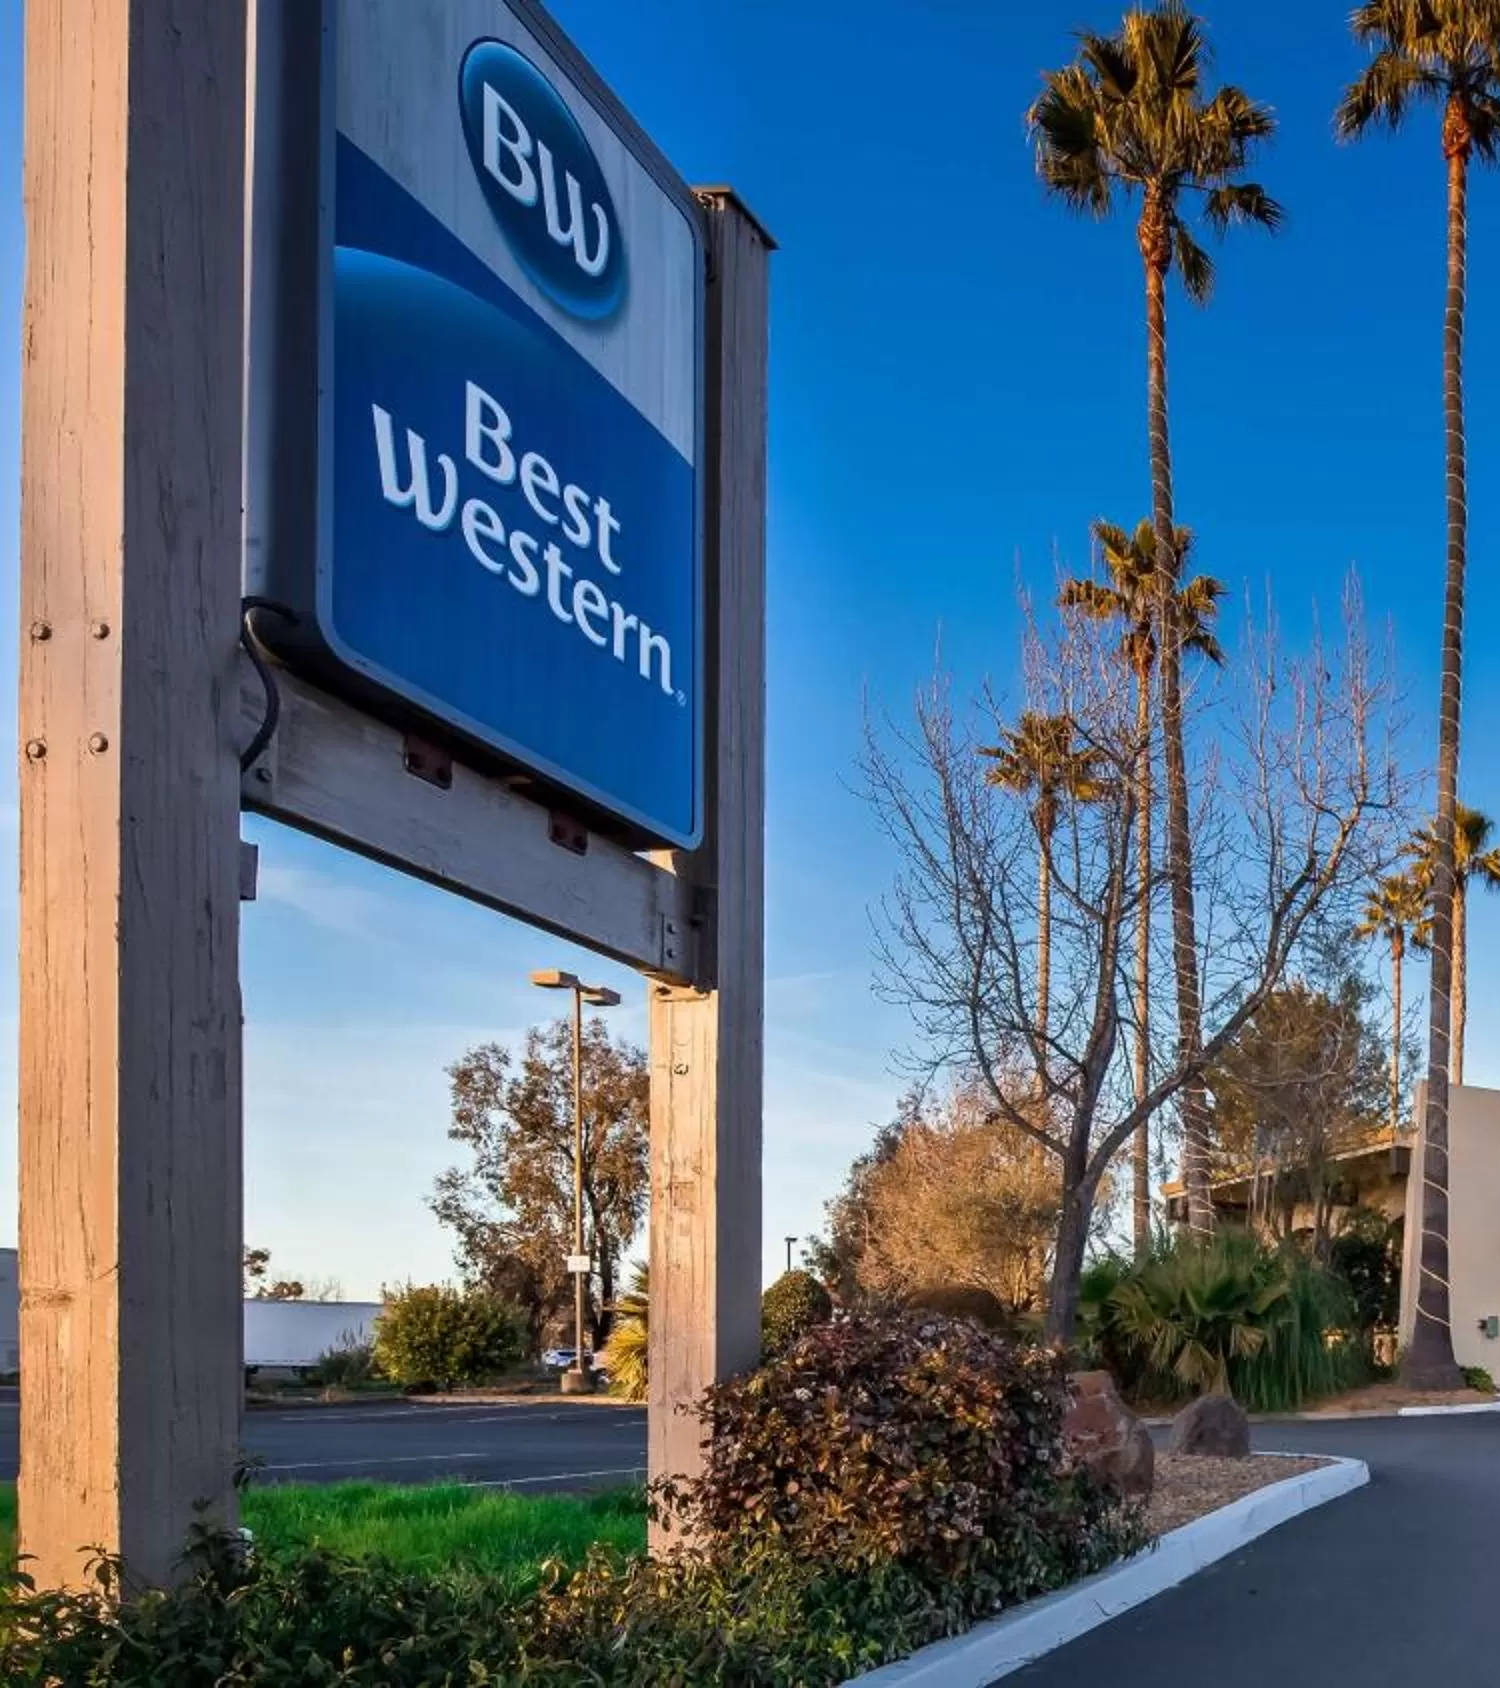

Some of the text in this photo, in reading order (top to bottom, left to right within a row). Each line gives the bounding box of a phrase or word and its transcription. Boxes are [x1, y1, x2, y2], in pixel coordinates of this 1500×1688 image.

[483, 80, 610, 277] BW
[372, 402, 676, 697] Western
[465, 379, 622, 576] Best
